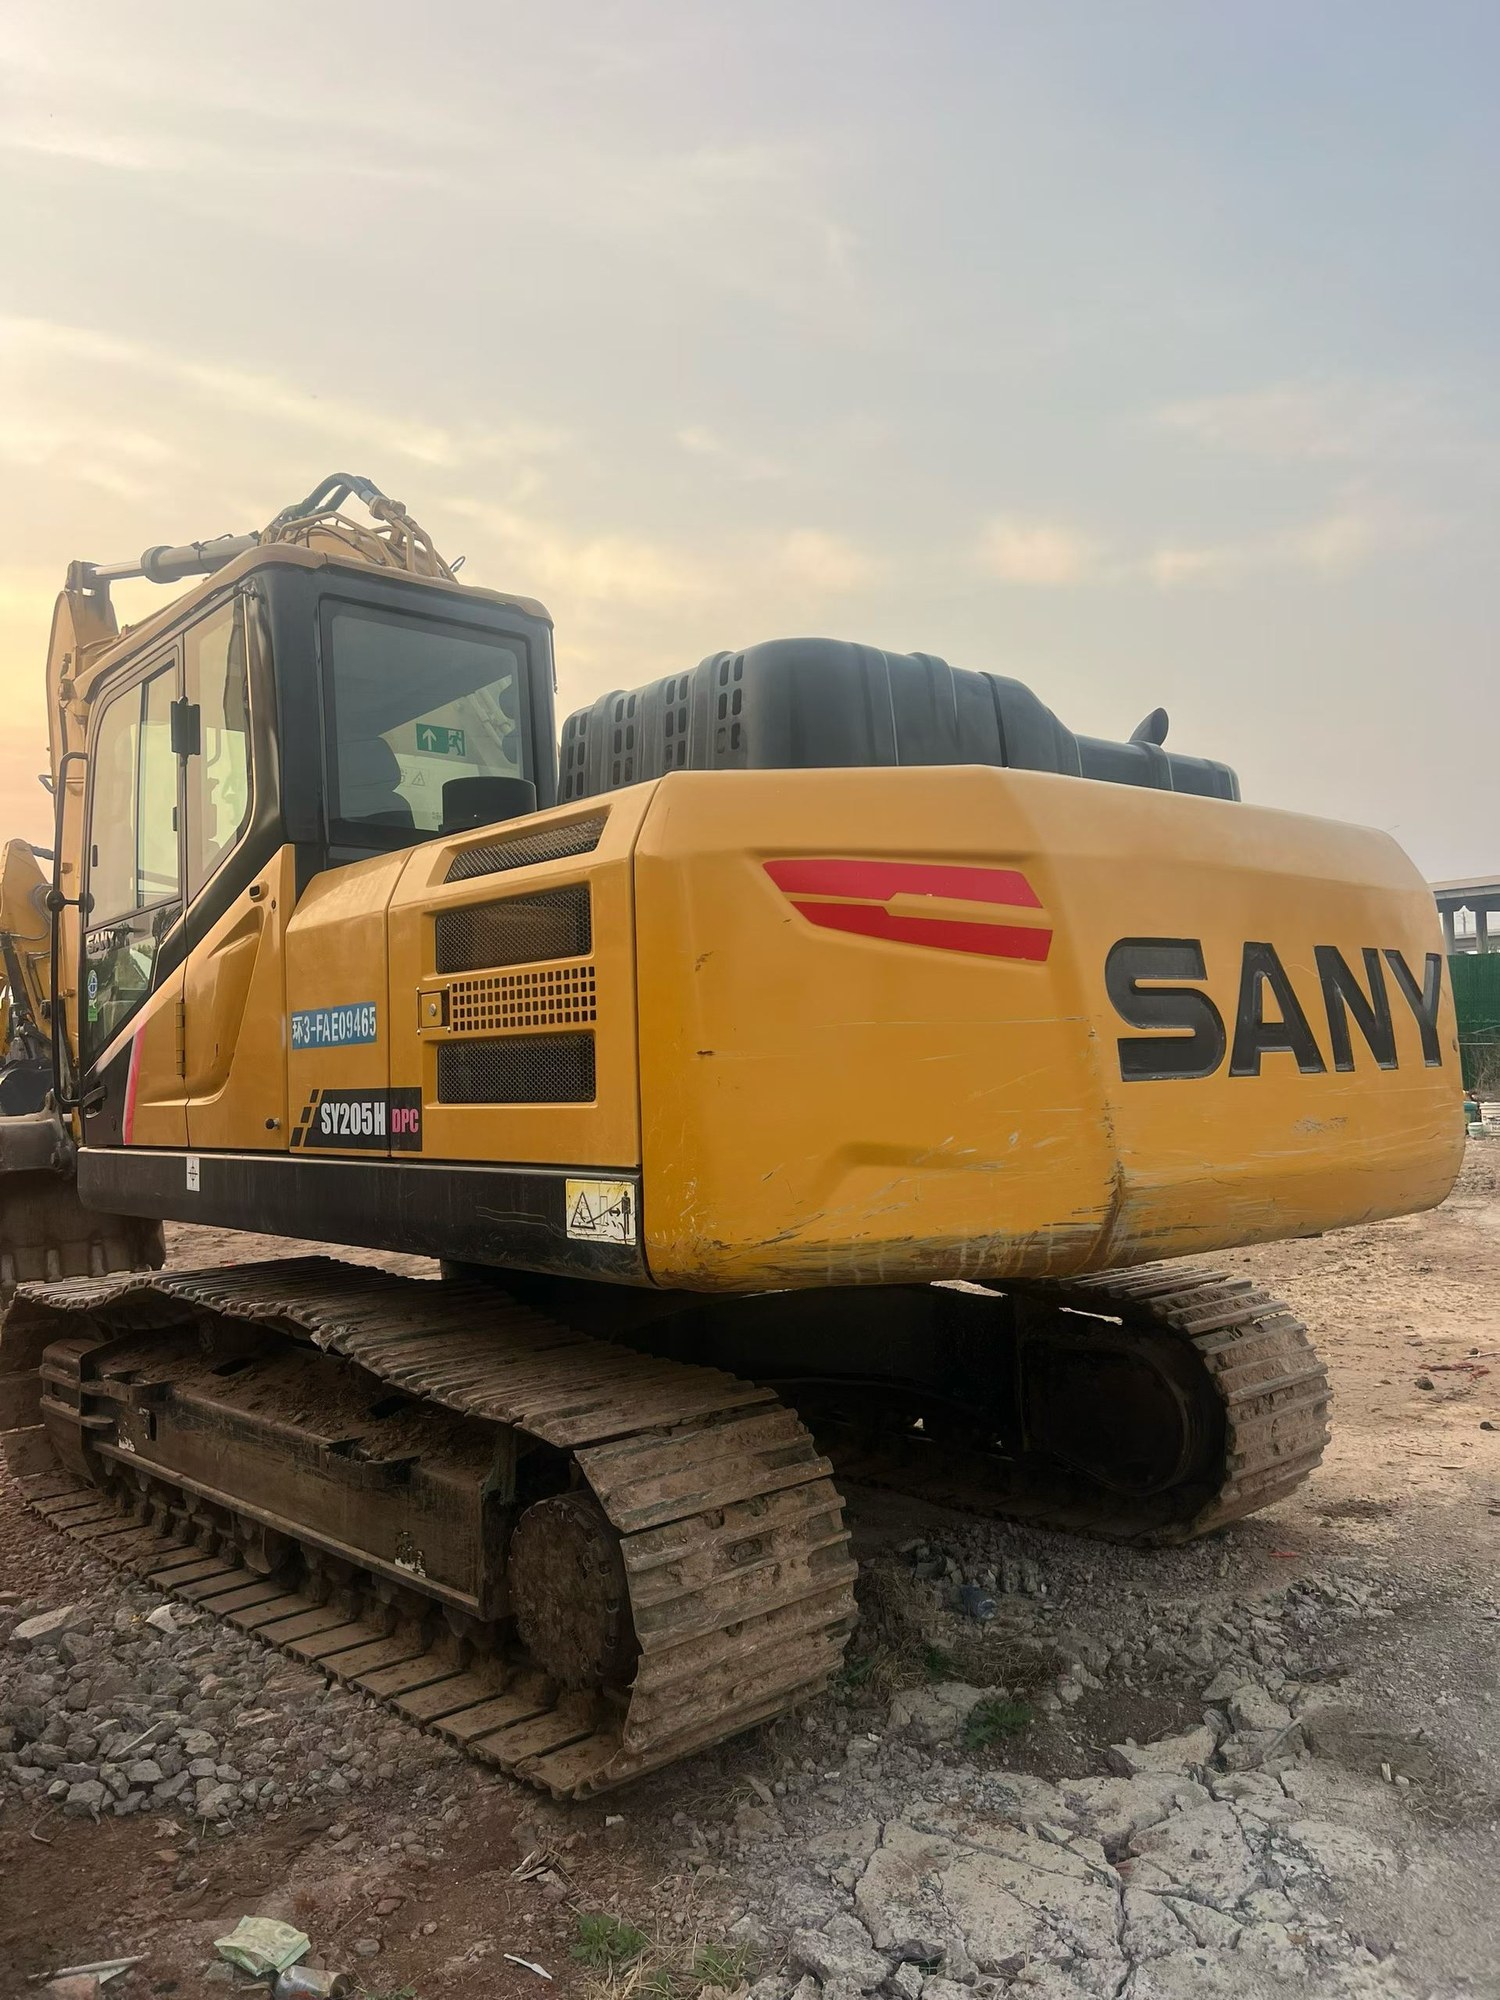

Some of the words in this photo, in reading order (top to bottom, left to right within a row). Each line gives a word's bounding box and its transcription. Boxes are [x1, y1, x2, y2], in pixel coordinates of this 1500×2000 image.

[86, 931, 114, 953] SANY
[1105, 937, 1442, 1081] SANY
[320, 1102, 386, 1135] SY205H
[391, 1108, 419, 1133] DPC
